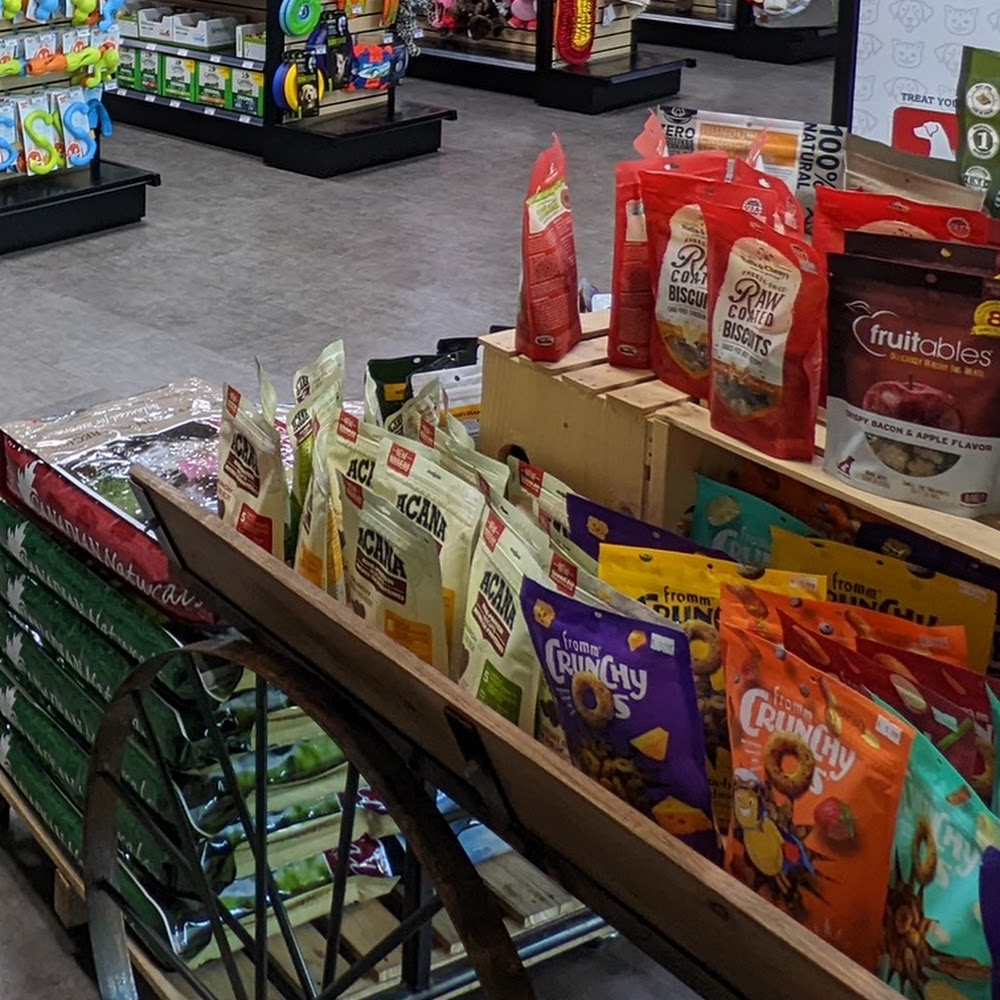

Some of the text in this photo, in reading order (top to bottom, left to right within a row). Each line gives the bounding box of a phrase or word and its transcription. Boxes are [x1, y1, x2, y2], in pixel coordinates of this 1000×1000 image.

[900, 92, 935, 104] TREAT
[661, 123, 696, 139] ERO
[796, 122, 817, 189] NATURAL
[671, 269, 708, 286] COAT
[668, 285, 708, 310] BISCUI
[727, 277, 786, 313] RAW
[727, 304, 775, 327] COATED
[722, 320, 772, 357] BISCUITS
[869, 323, 993, 368] fruitables
[870, 419, 905, 436] BACON
[905, 428, 914, 437] &
[915, 431, 949, 447] APPLE
[951, 439, 994, 452] FLAVOR
[28, 488, 101, 559] CANADIAN
[240, 511, 247, 523] 5
[396, 493, 448, 542] ACANA
[357, 526, 408, 580] ACANA
[479, 571, 517, 633] ACANA
[663, 585, 711, 606] fromm
[832, 571, 877, 600] fromm
[562, 630, 599, 657] fromm
[482, 670, 490, 683] 5
[545, 637, 648, 701] CRUNCHY
[773, 685, 814, 721] fromm
[739, 687, 857, 783] CRUNCHY
